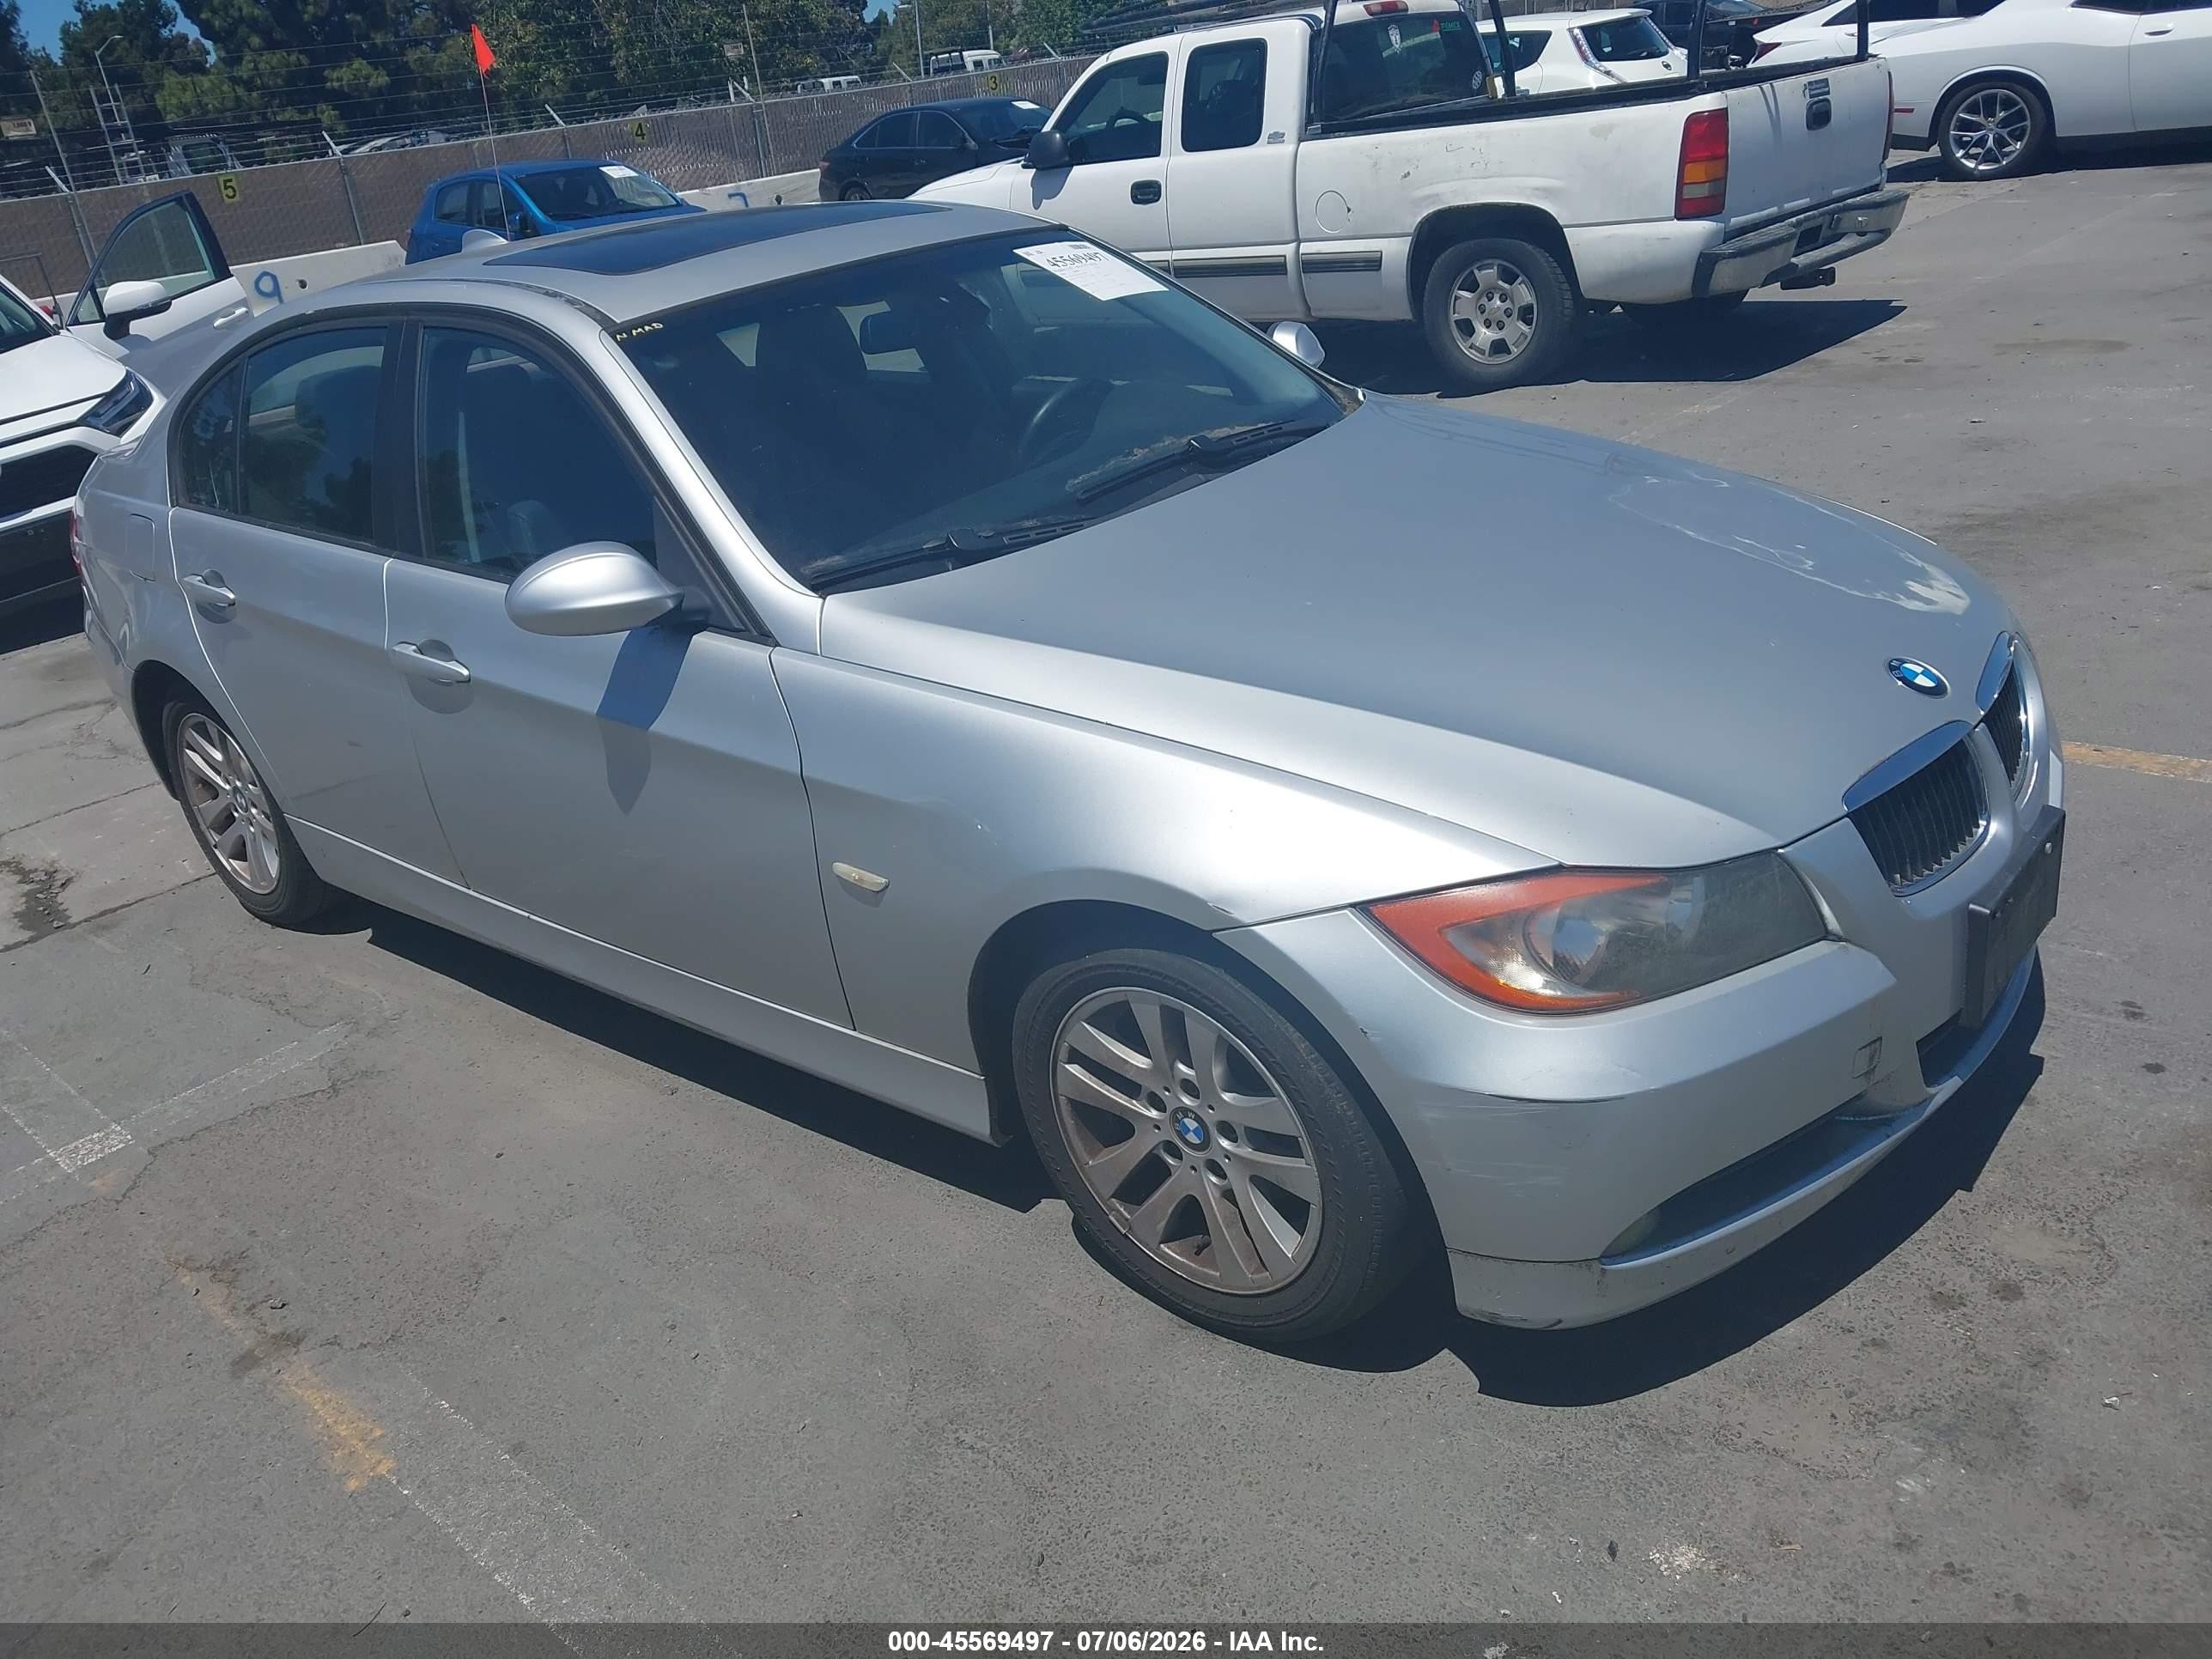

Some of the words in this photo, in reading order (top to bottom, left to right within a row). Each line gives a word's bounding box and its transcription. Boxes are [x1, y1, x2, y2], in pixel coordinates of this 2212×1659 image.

[989, 75, 999, 91] 3
[635, 122, 647, 140] 4
[222, 178, 237, 199] 5
[727, 191, 750, 208] 7
[1046, 252, 1109, 268] 45569497
[253, 270, 284, 304] 9
[616, 332, 628, 342] N
[631, 322, 664, 337] MAD
[1175, 1111, 1195, 1131] BMW
